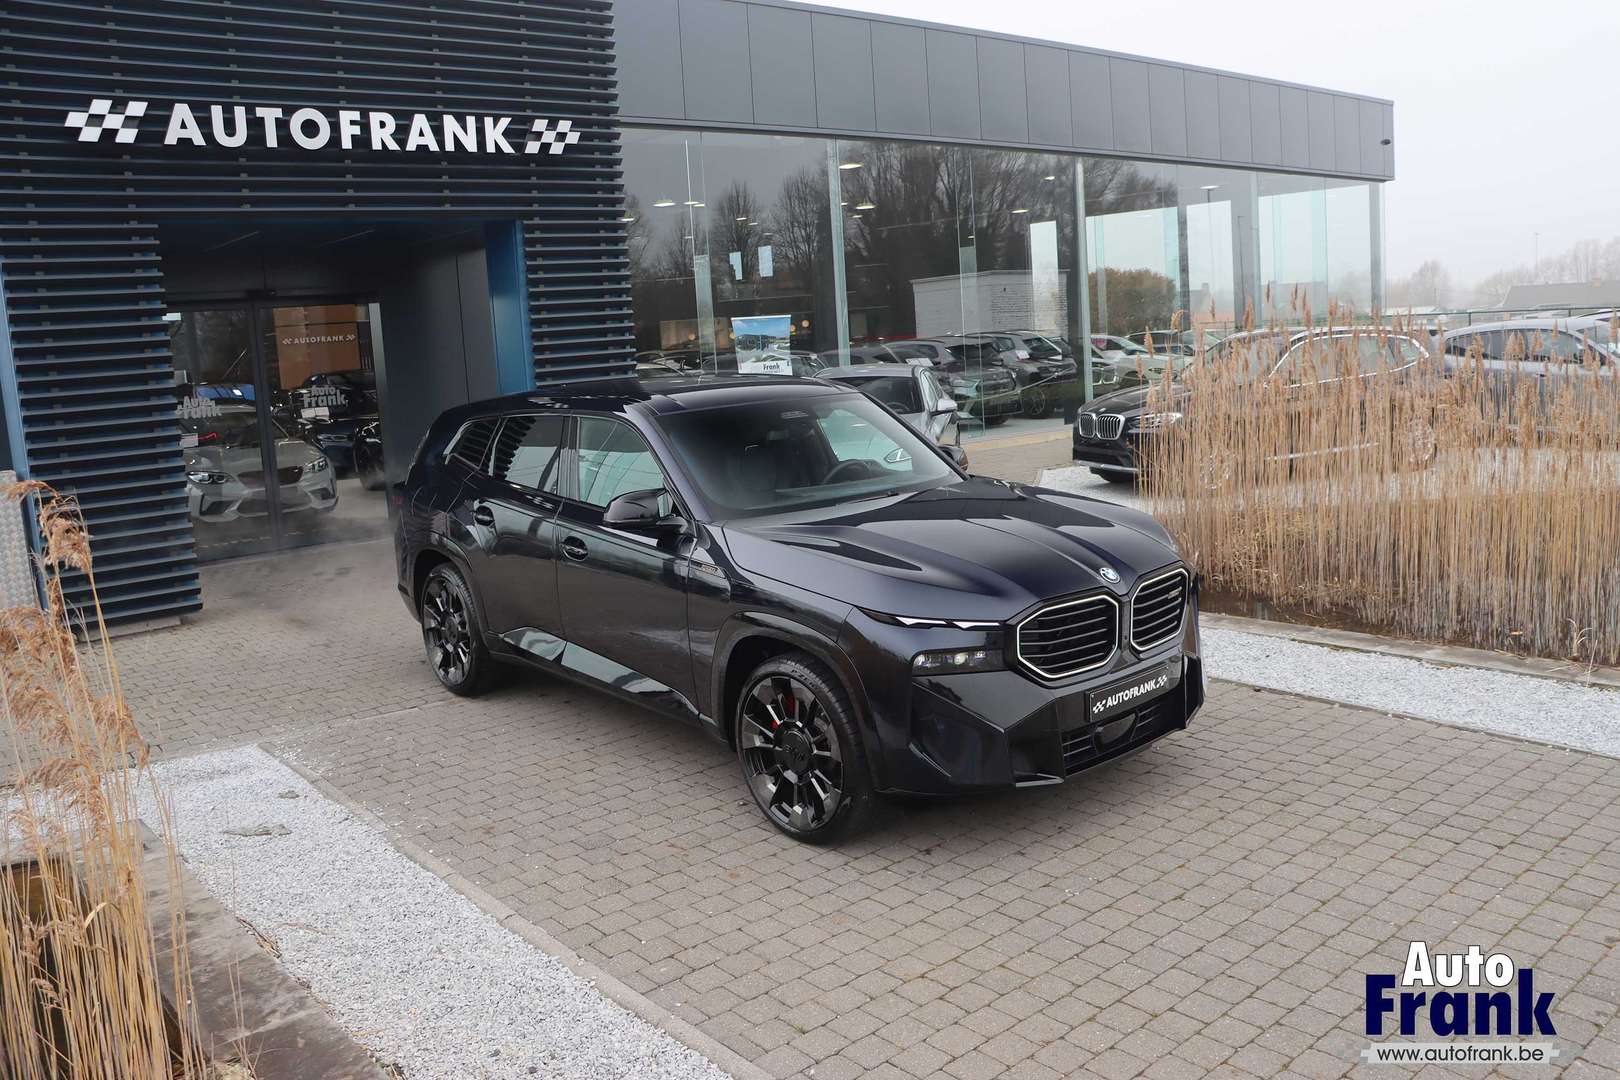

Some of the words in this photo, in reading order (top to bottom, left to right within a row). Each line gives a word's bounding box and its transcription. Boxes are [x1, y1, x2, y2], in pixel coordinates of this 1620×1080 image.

[164, 103, 516, 153] AUTOFRANK
[294, 335, 345, 345] AUTOFRANK
[303, 389, 346, 408] Frank
[1106, 679, 1156, 708] AUTOFRANK
